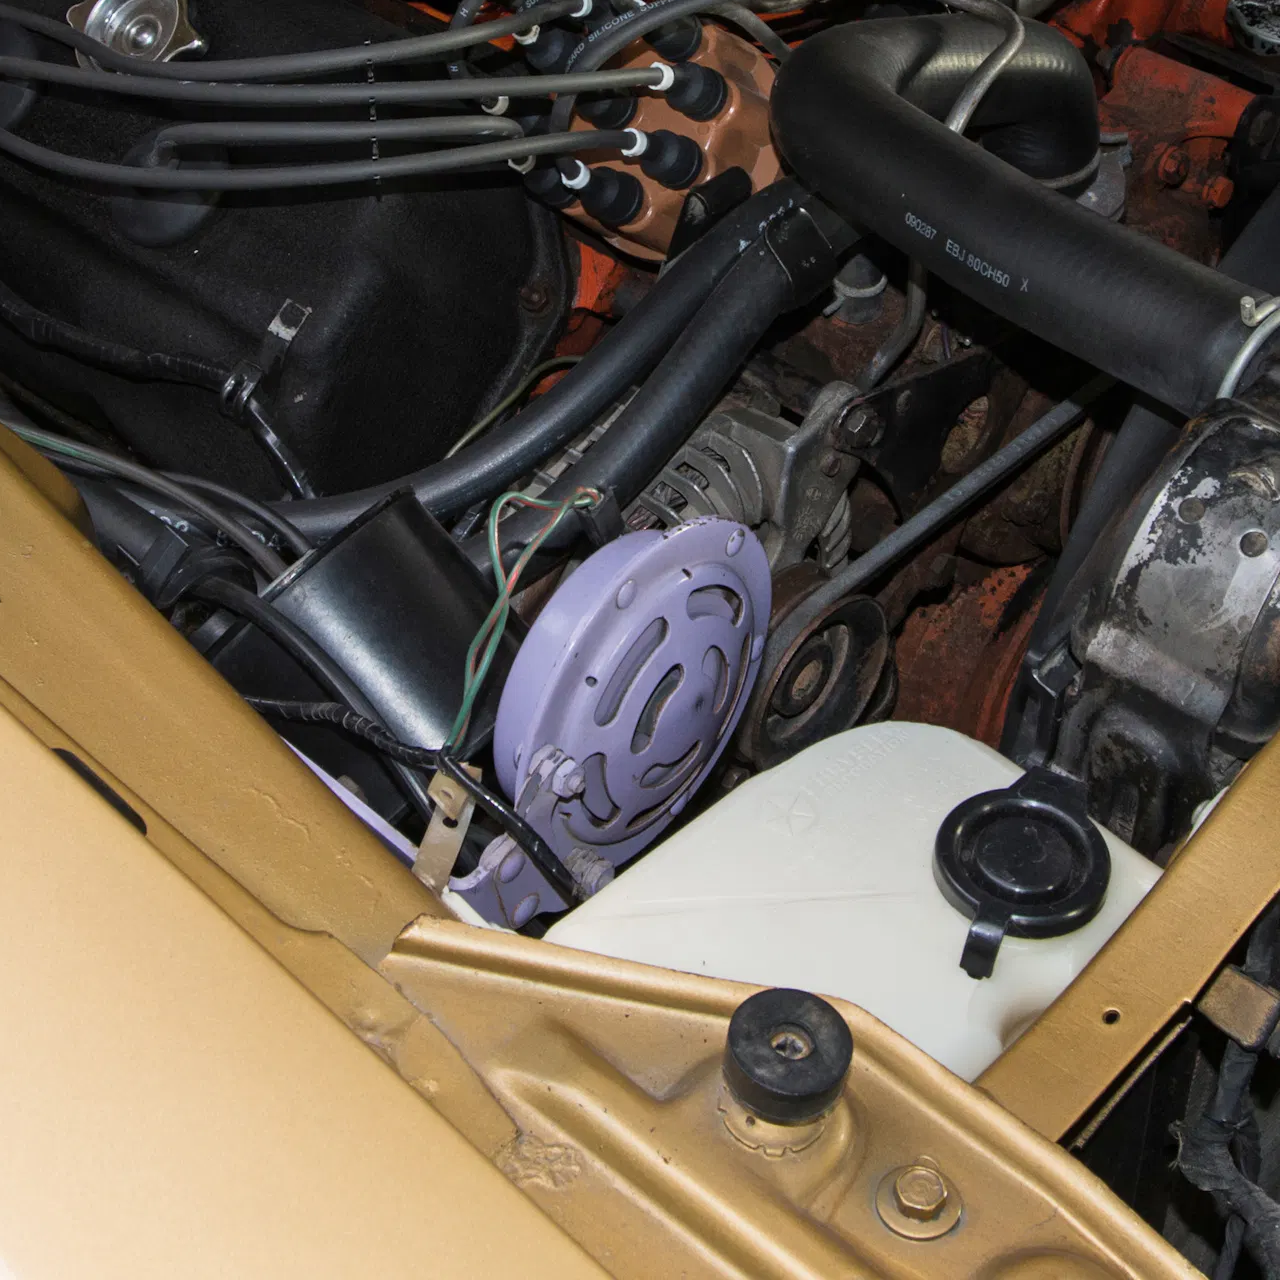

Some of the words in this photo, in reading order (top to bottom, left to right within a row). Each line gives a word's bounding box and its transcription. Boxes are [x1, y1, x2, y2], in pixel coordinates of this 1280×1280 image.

[587, 9, 635, 42] SILICONE
[945, 239, 966, 261] EBJ
[1020, 277, 1030, 293] X
